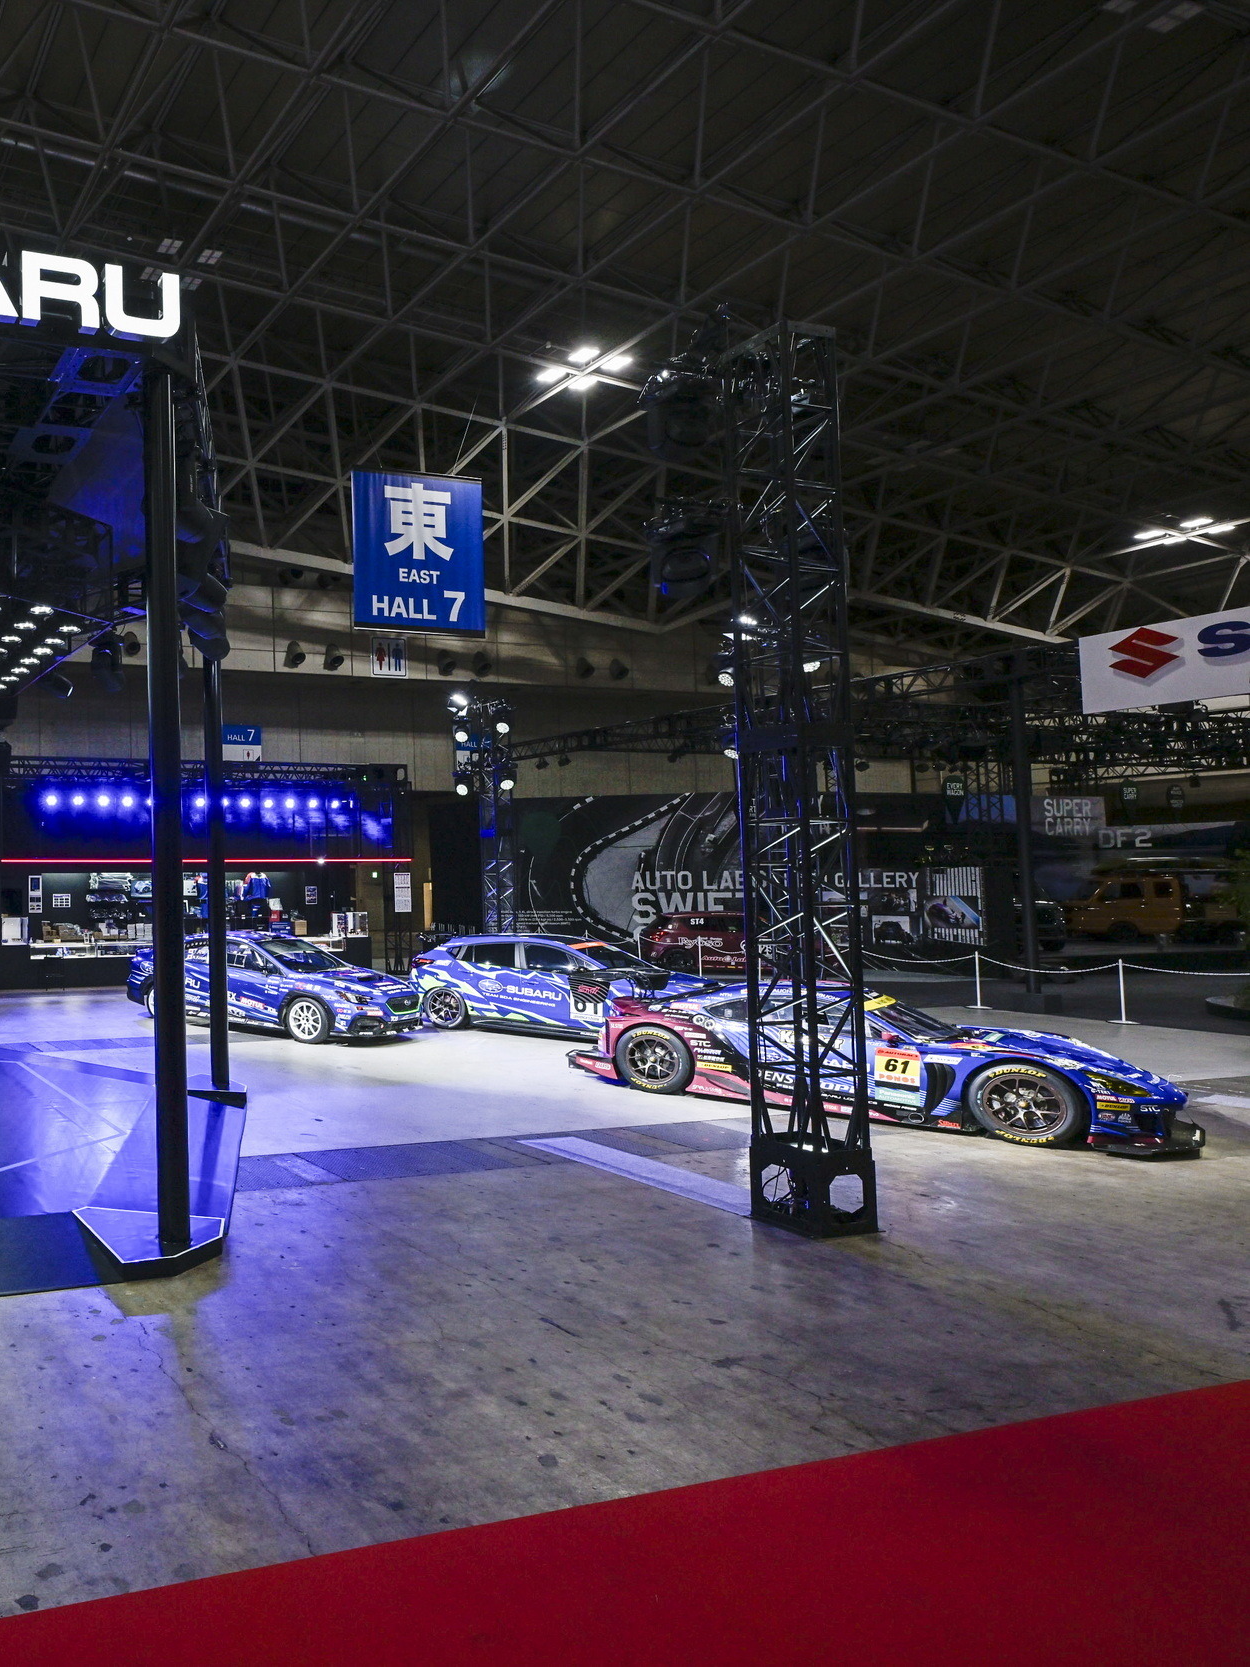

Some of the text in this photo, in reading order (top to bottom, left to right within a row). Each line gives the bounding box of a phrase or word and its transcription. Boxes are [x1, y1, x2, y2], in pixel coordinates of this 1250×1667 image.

[384, 483, 454, 561] 東
[399, 568, 440, 584] EAST
[372, 590, 465, 622] HALL 7
[227, 729, 255, 742] HALL 7
[1043, 798, 1092, 817] SUPER
[1045, 817, 1091, 837] CARRY
[631, 871, 693, 890] AUTO
[834, 871, 919, 889] GLLERY
[506, 985, 562, 1001] SUBARU
[636, 1030, 670, 1040] DUNLOP
[884, 1058, 910, 1074] 61
[995, 1068, 1047, 1078] DUNLOP
[879, 1073, 916, 1084] PONOS
[879, 1089, 916, 1099] Panasonic
[1140, 1104, 1160, 1112] STC
[995, 1129, 1048, 1143] DUNLOP
